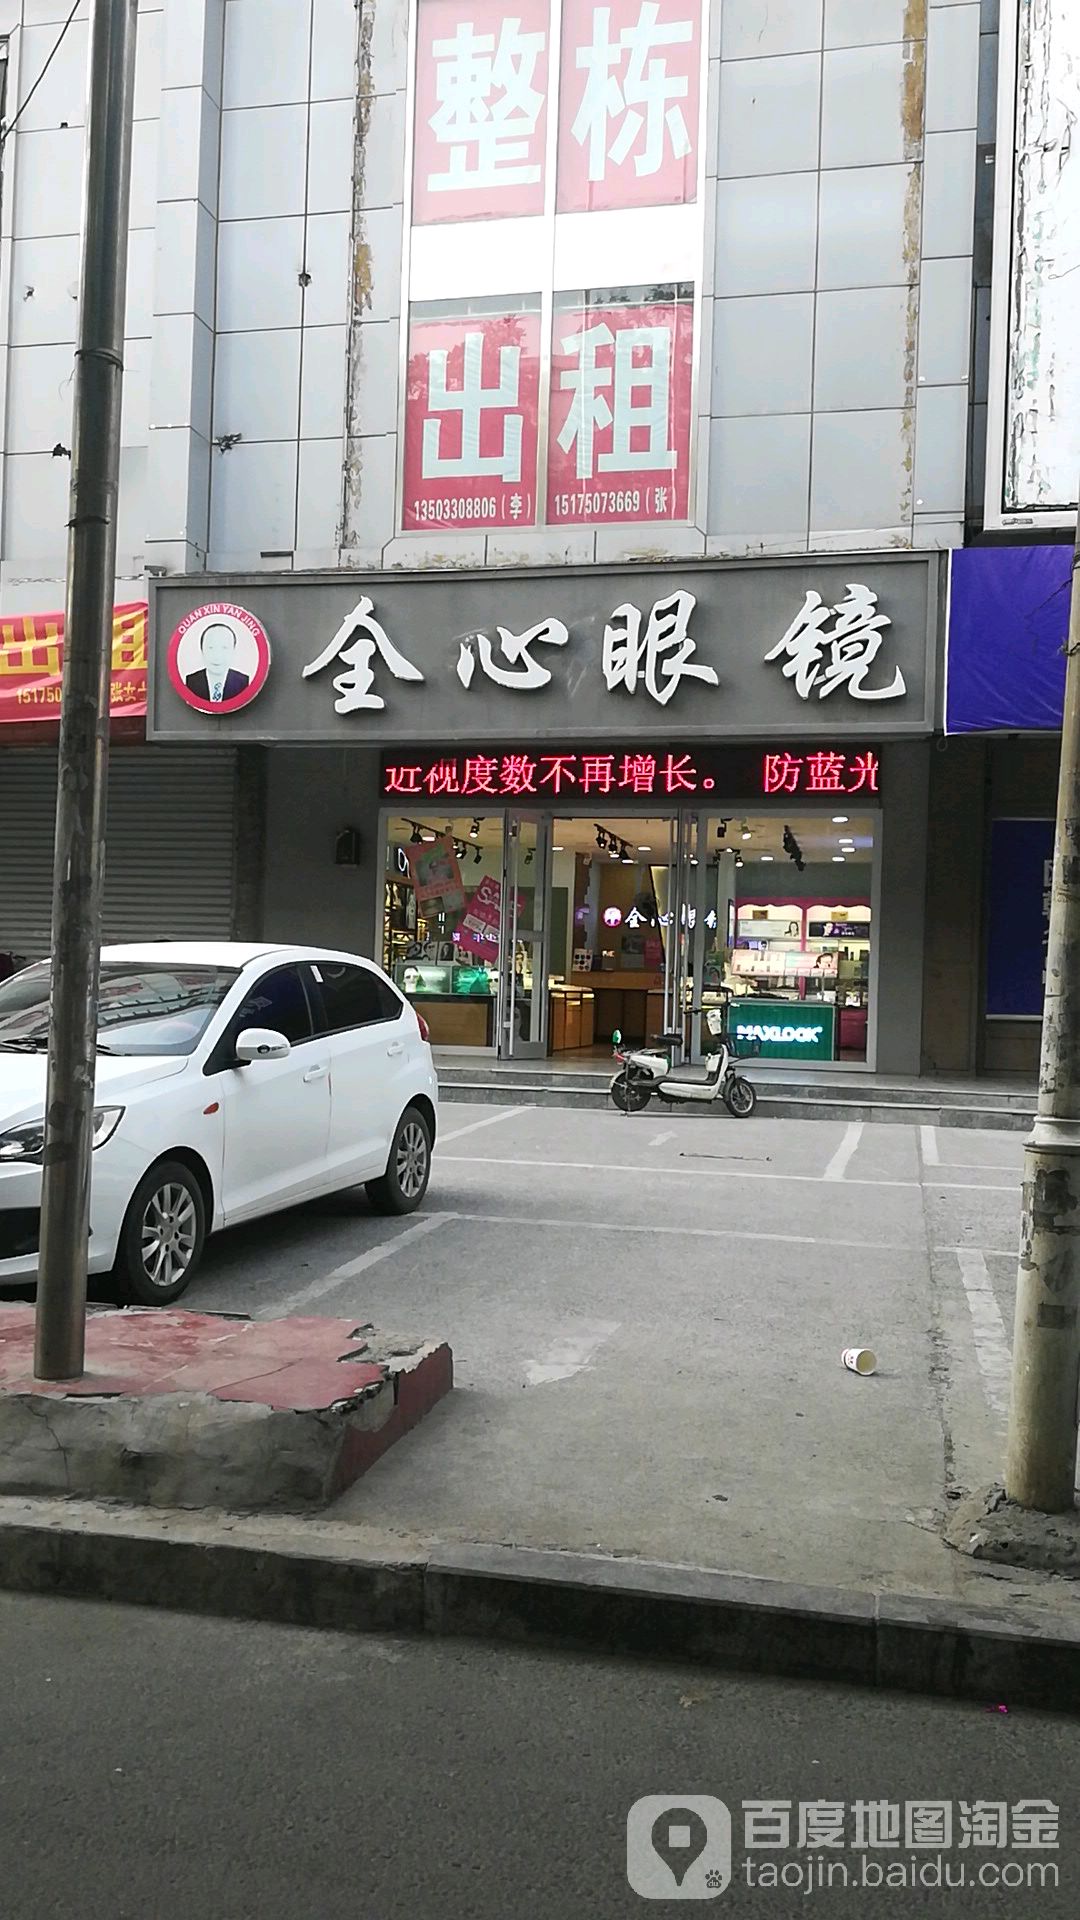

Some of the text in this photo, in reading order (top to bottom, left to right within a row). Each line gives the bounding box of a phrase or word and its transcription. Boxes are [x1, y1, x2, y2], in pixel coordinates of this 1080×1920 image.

[427, 2, 694, 192] 整栋
[422, 322, 678, 483] 出租
[178, 604, 260, 637] QUAN XIN YAN JING
[302, 583, 908, 715] 全心眼镜
